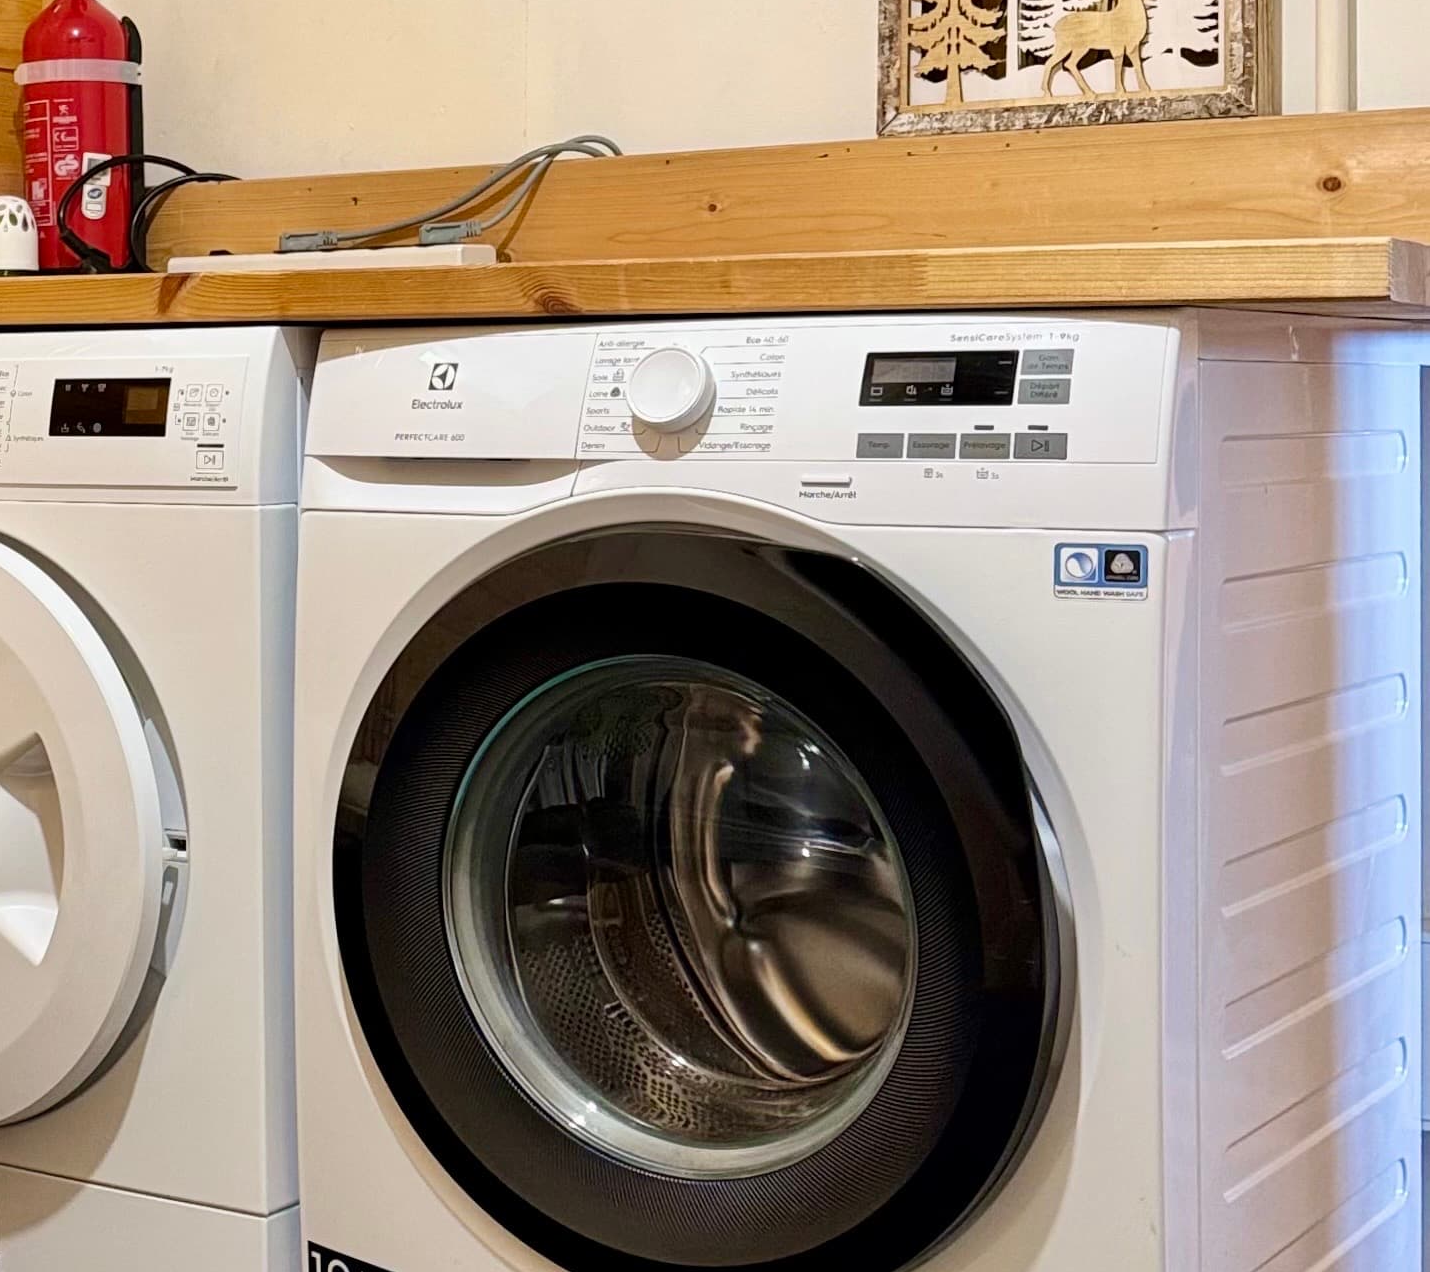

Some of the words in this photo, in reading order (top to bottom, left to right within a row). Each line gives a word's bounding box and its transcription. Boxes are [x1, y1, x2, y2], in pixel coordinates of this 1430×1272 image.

[411, 398, 463, 410] Electrolux
[395, 433, 449, 442] PERFECTCARE
[450, 433, 466, 442] 600
[799, 490, 857, 499] Marche/Arrêt
